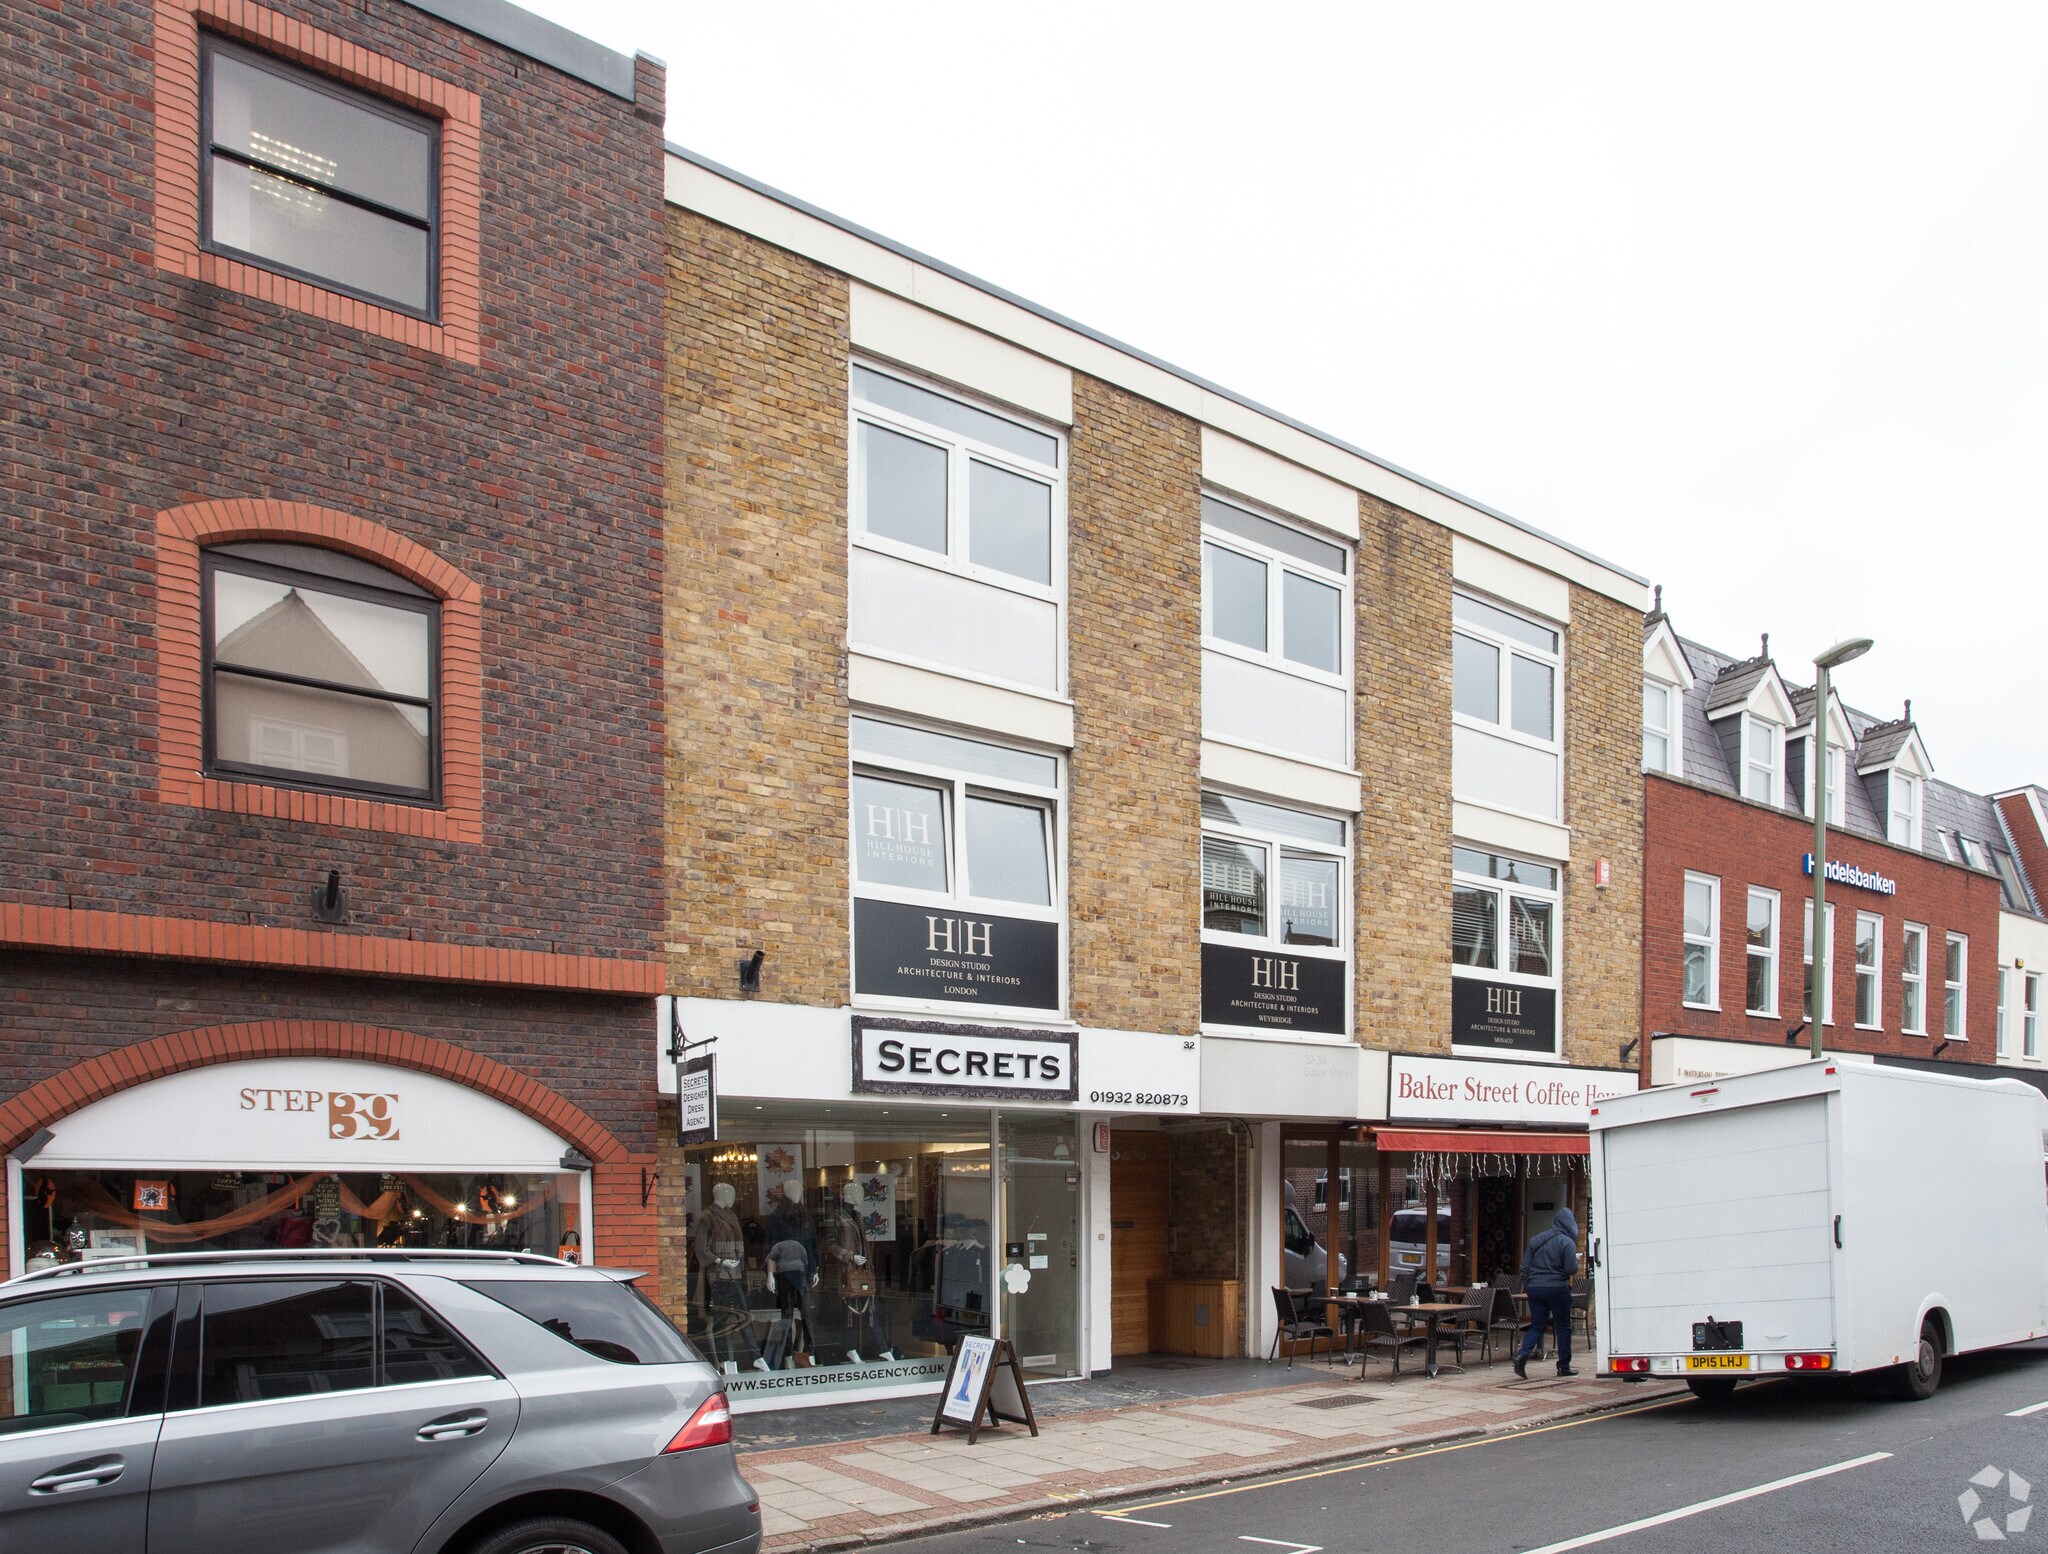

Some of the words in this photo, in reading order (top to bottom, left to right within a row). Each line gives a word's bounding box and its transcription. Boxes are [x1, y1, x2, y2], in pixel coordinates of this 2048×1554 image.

[866, 839, 894, 852] HILL
[896, 843, 933, 857] HOUSE
[867, 849, 935, 867] INTERIORS
[1808, 852, 1895, 895] Hndelsbanken
[1209, 891, 1231, 903] HILL
[1230, 894, 1258, 907] HOUSE
[1210, 901, 1258, 914] INTERIORS
[1300, 909, 1329, 919] HOUSE
[930, 957, 960, 968] DESIGN
[961, 961, 991, 972] STUDIO
[897, 966, 964, 980] ARCHITECTURE
[966, 973, 973, 981] &
[976, 974, 1021, 986] INTERIORS
[944, 985, 978, 996] LONDON
[1254, 992, 1276, 1000] DESIGN
[1276, 994, 1298, 1003] STUDIO
[1230, 999, 1278, 1011] ARCHITECTURE
[1286, 1005, 1319, 1015] INTERIORS
[1258, 1014, 1293, 1024] WEYBRIDGE
[1504, 1018, 1520, 1026] STUDIO
[1470, 1024, 1506, 1033] ARCHITECTURE
[1511, 1027, 1536, 1036] INTERIORS
[1182, 1041, 1195, 1050] 32
[1493, 1036, 1514, 1044] MONACO
[878, 1039, 1061, 1081] SECRETS
[683, 1075, 708, 1089] SECRETS
[1398, 1072, 1459, 1101] Baker
[1463, 1076, 1519, 1104] Street
[1525, 1080, 1580, 1107] Coffee
[683, 1090, 708, 1103] DESIGNER
[1090, 1090, 1133, 1104] 01932
[1135, 1092, 1189, 1107] 820873
[240, 1087, 324, 1113] STEP
[329, 1091, 400, 1141] 39
[687, 1103, 704, 1114] DRESS
[686, 1116, 706, 1127] AGENCY
[964, 1340, 992, 1352] SECRETS
[1692, 1356, 1717, 1368] DP15
[1719, 1355, 1743, 1368] LHJ
